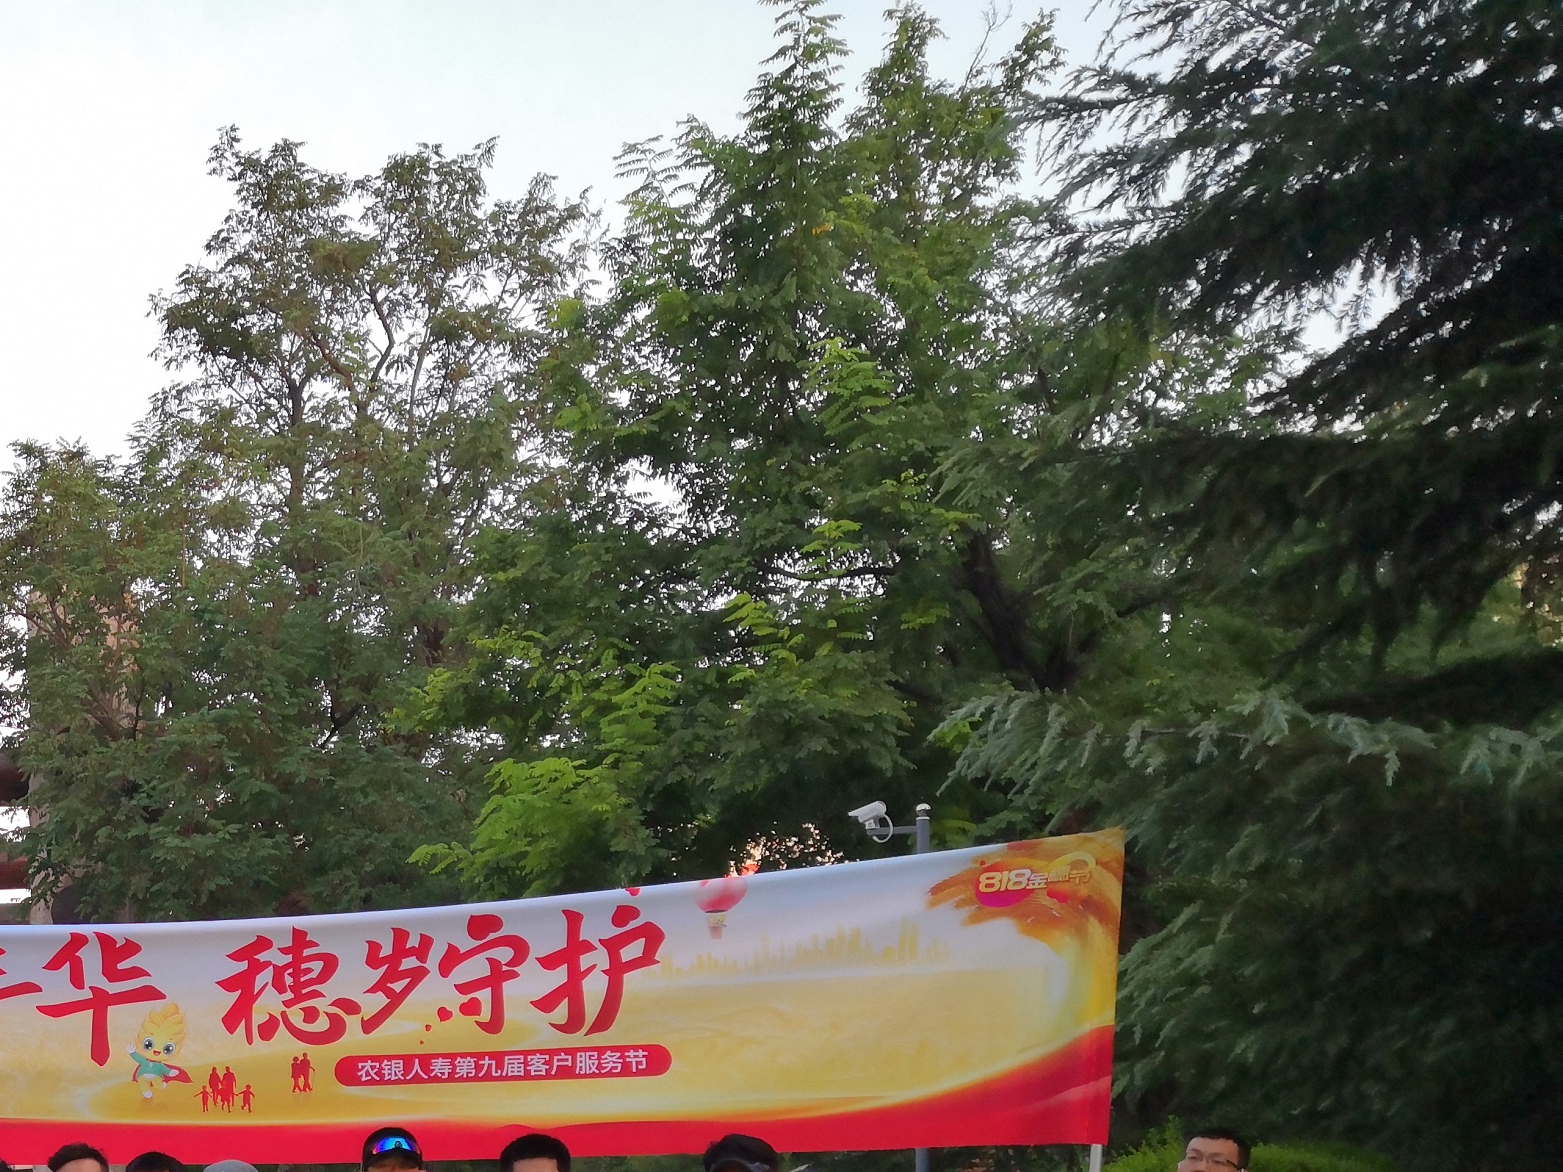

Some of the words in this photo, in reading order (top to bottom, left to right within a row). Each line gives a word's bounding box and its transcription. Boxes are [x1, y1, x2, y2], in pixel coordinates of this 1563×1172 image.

[215, 904, 667, 1047] 穗岁守护
[356, 1048, 649, 1083] 农银人寿第九届客户服务节
